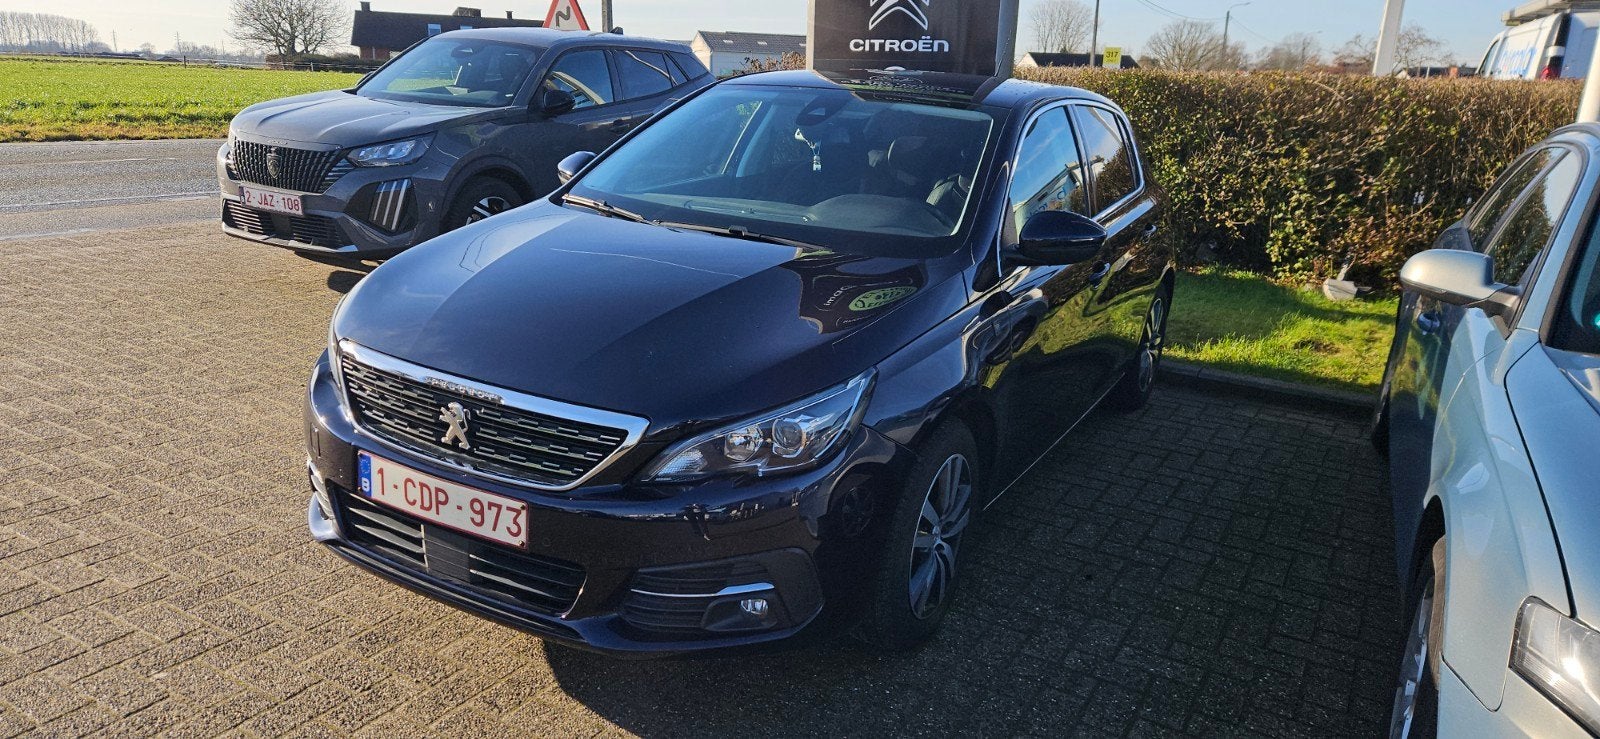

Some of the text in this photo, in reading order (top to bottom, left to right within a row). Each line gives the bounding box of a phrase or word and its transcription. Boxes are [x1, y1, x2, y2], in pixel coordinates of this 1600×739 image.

[245, 190, 300, 212] 2-JAZ-108
[361, 477, 371, 493] B
[377, 466, 523, 539] 1-CDP-973
